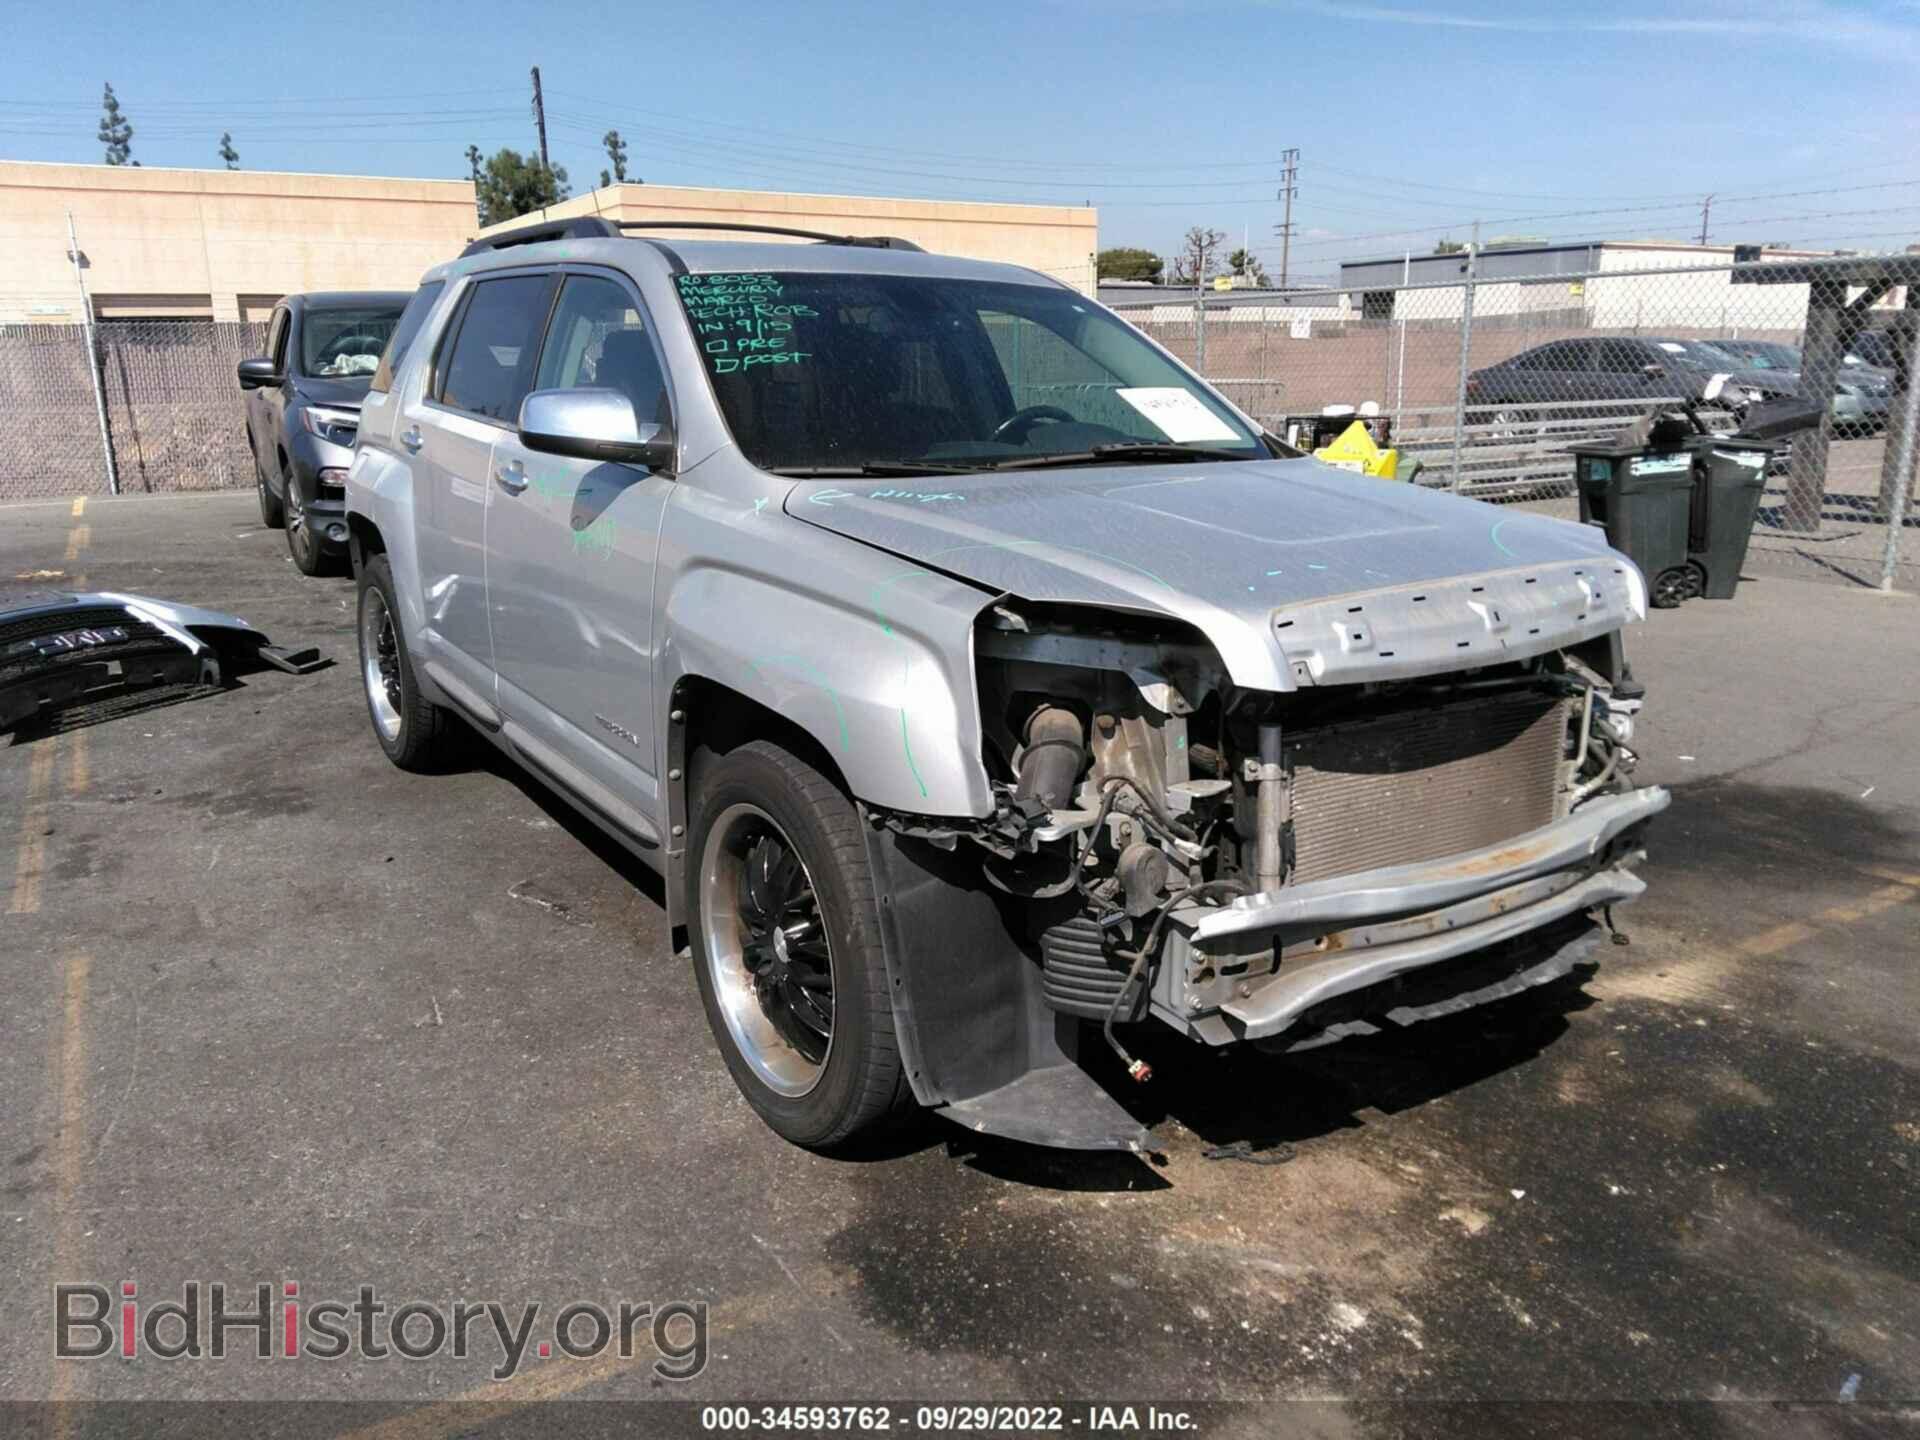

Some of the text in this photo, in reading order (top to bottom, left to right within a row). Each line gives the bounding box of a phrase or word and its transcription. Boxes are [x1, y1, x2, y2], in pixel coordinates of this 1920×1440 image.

[679, 284, 784, 297] MERCURY
[736, 337, 787, 352] PRE
[743, 352, 813, 371] POST
